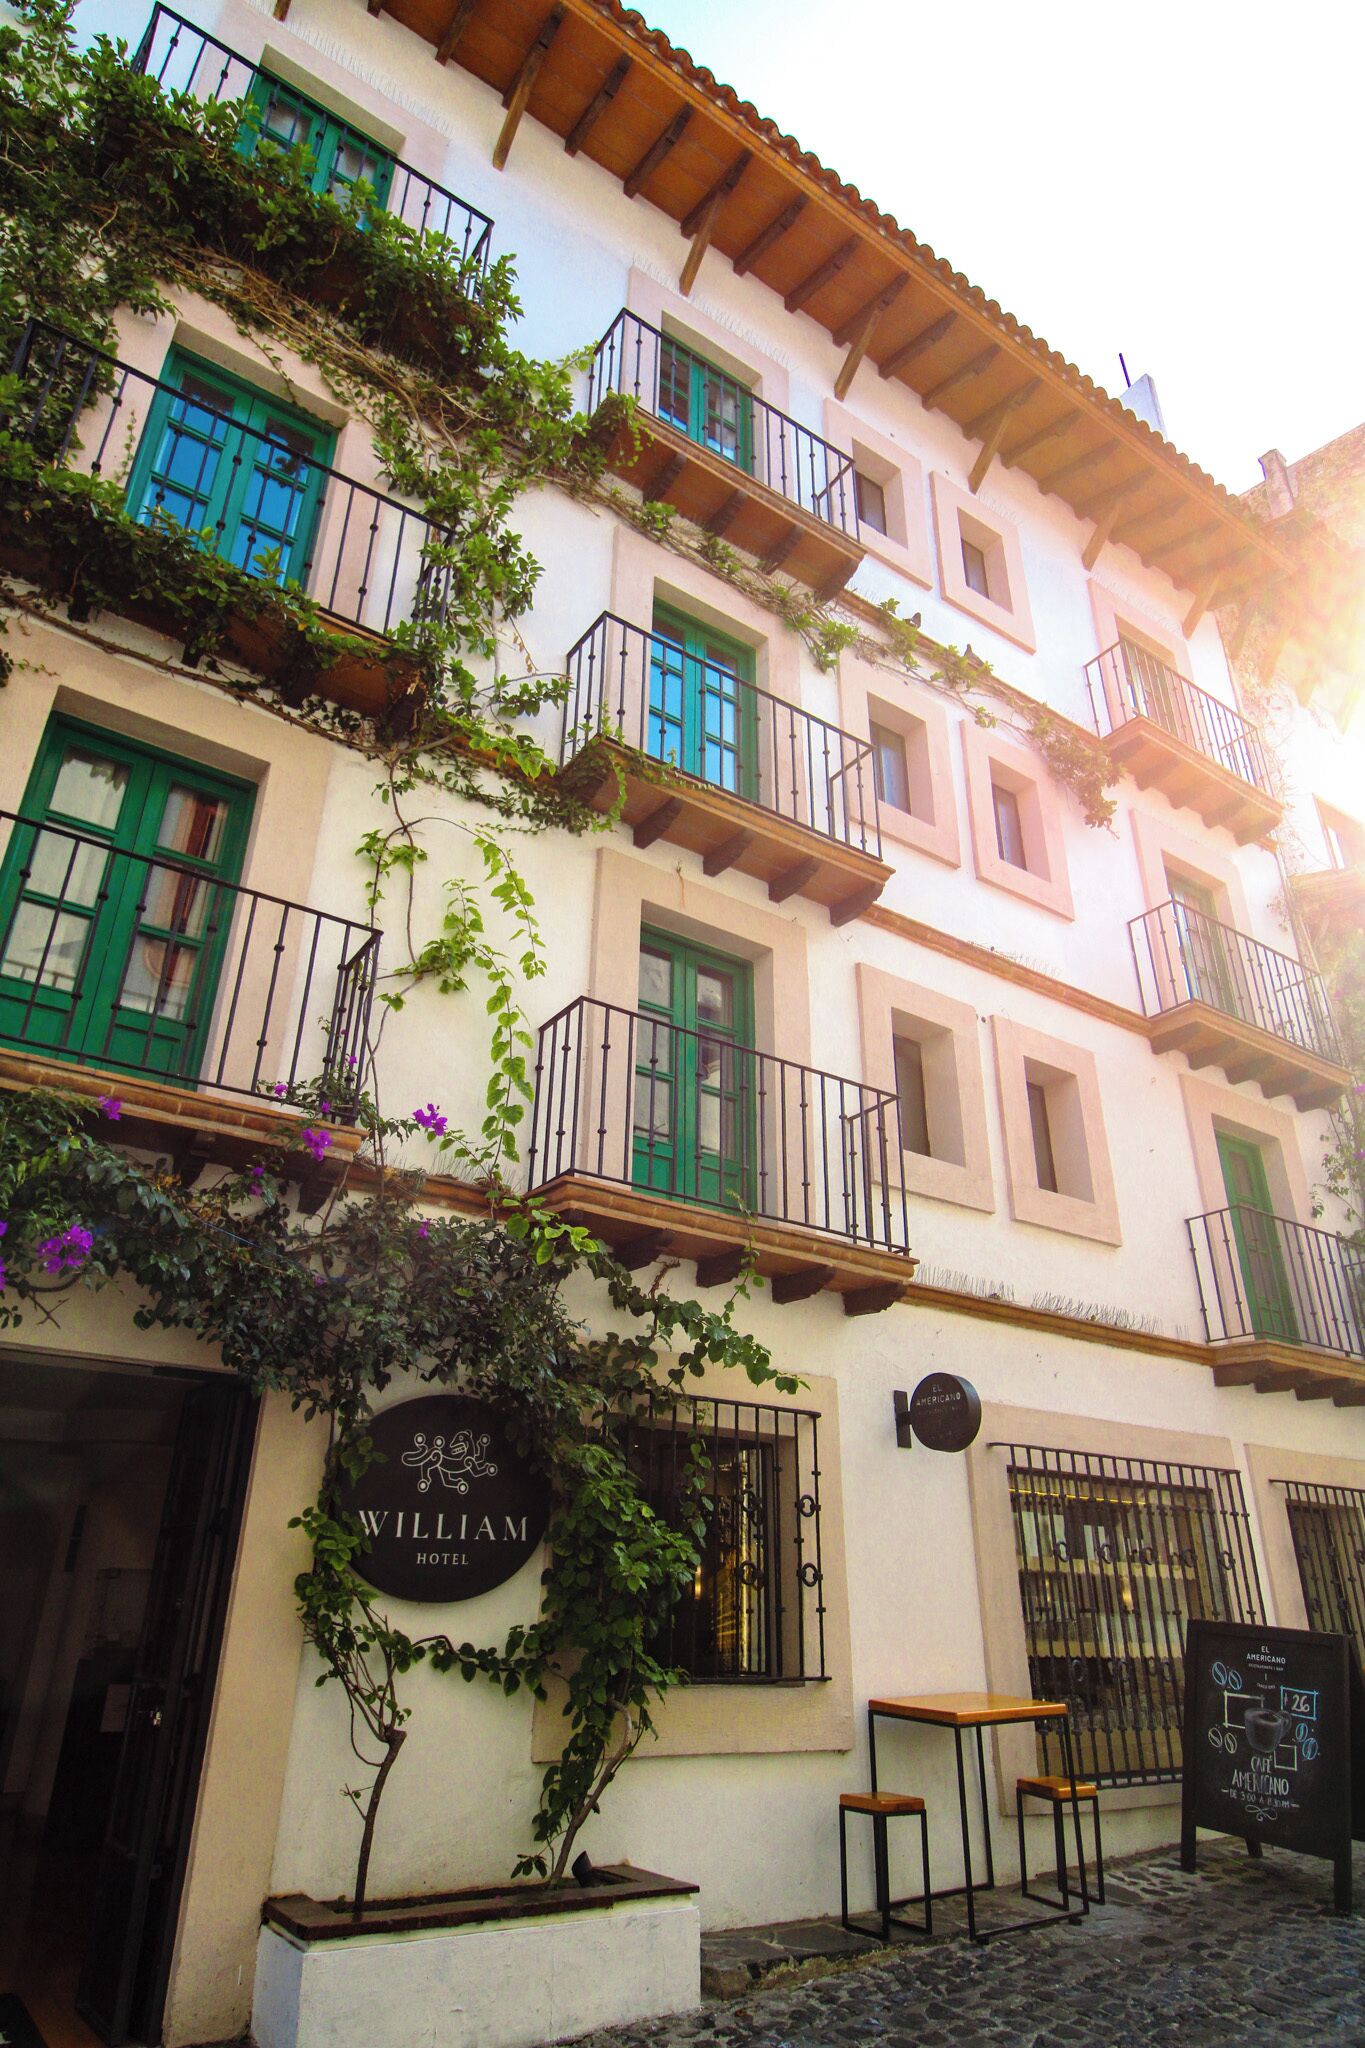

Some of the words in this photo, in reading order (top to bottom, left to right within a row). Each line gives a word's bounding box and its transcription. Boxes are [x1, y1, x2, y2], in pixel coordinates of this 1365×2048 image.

[916, 1392, 961, 1406] AMERICANO
[358, 1510, 528, 1542] WILLIAM
[416, 1553, 469, 1565] HOTEL
[1261, 1645, 1270, 1653] EL
[1246, 1653, 1286, 1664] AMERICANO
[1231, 1768, 1290, 1796] AMERICANO
